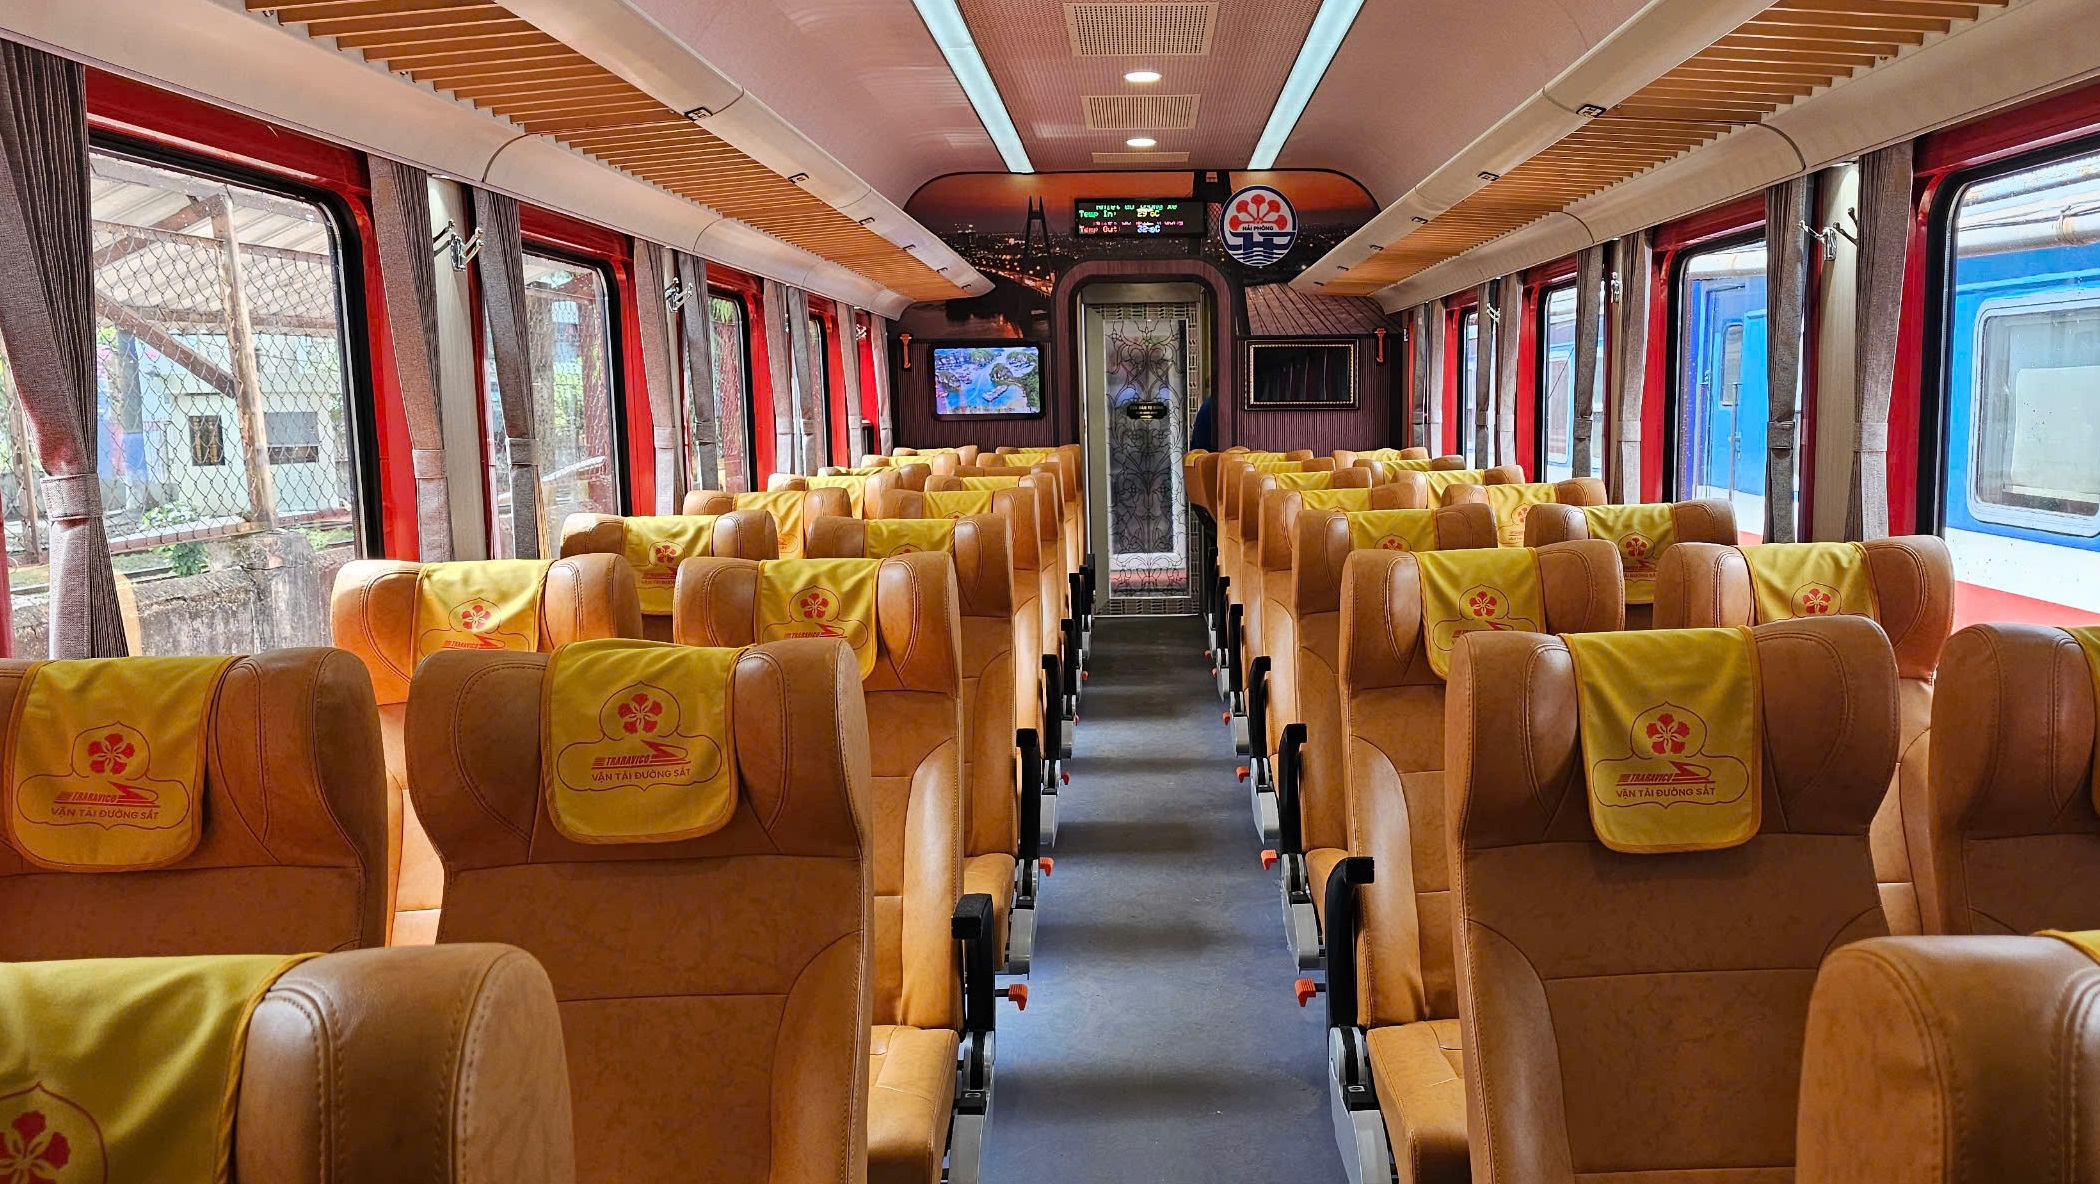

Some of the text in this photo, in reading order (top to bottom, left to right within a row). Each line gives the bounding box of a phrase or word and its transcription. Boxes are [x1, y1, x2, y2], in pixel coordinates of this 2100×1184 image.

[1079, 209, 1099, 218] Temp
[592, 767, 691, 783] VẬN TẢI ĐƯỜNG SẮT
[1615, 784, 1716, 800] VẬN TẢI ĐƯỜNG SẮT
[51, 806, 76, 818] VẬN
[99, 808, 140, 820] ĐƯỜNG
[140, 808, 160, 820] SẮT
